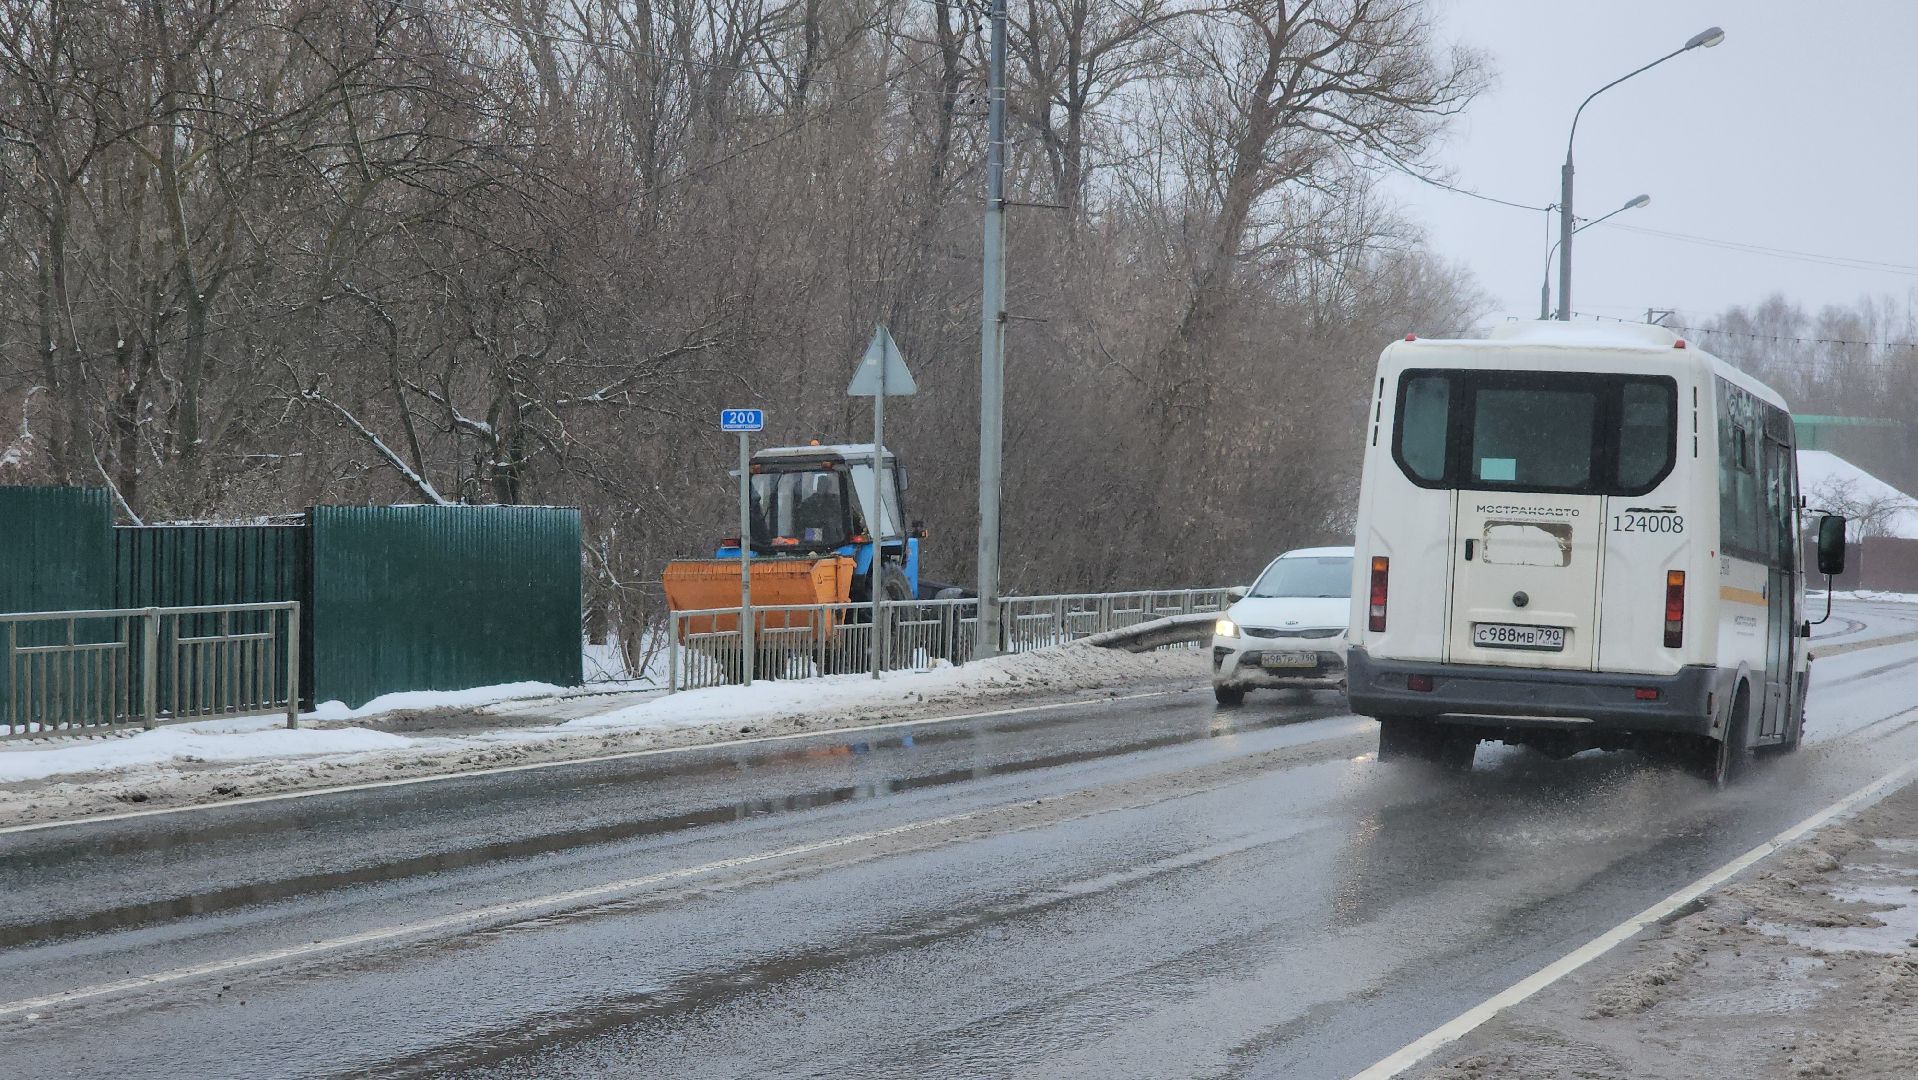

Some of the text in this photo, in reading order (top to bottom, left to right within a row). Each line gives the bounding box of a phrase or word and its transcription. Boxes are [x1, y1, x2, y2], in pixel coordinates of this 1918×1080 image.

[729, 412, 755, 424] 200
[1476, 504, 1580, 517] МОСТРАНСАВТО
[1613, 514, 1684, 533] 124008
